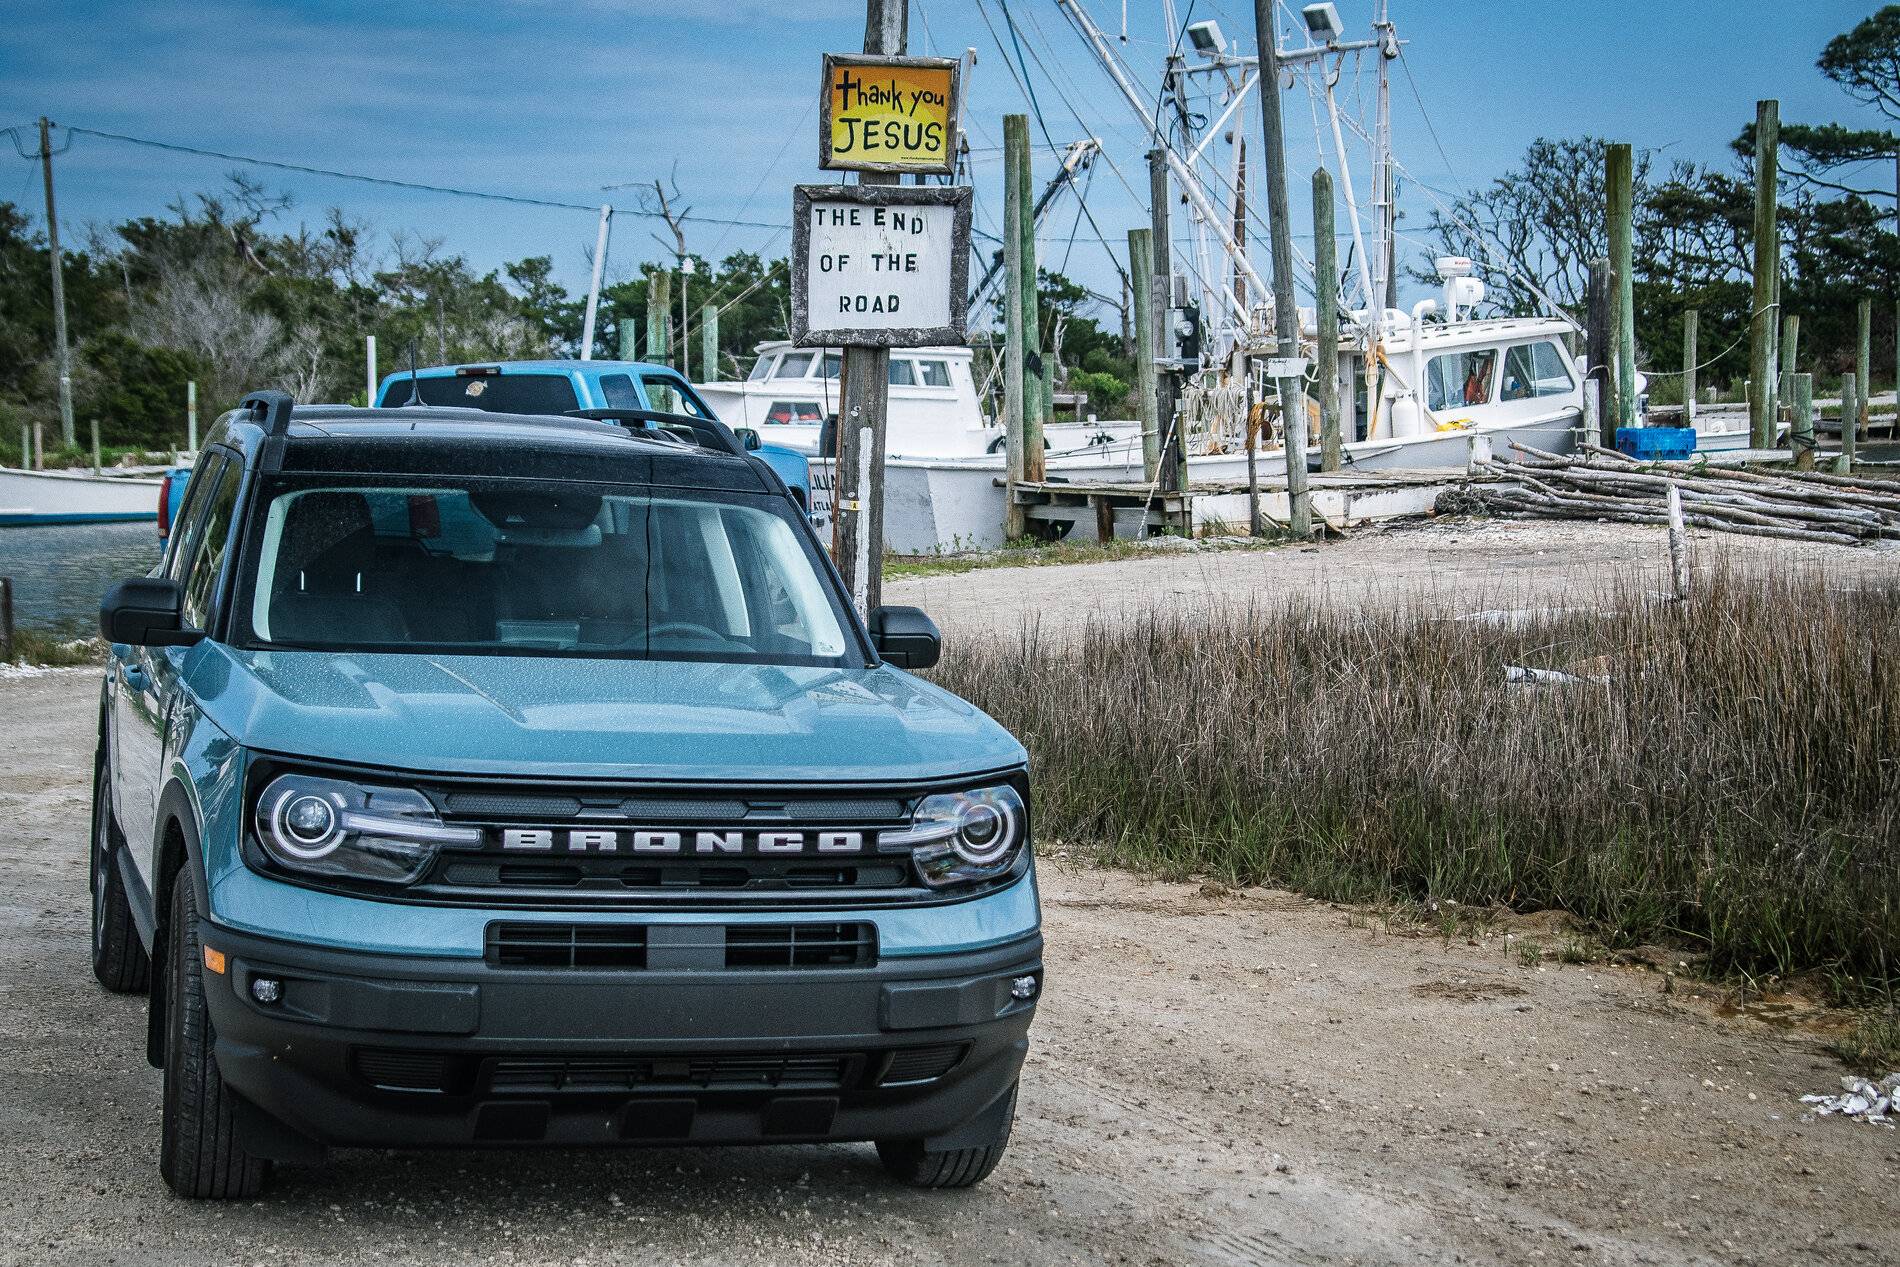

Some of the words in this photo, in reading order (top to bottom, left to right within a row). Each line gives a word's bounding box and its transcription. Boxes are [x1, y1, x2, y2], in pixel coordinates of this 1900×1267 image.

[909, 90, 945, 117] you
[834, 117, 943, 153] JESUS
[815, 208, 862, 226] THE
[873, 208, 924, 235] END
[820, 254, 850, 273] OF
[871, 253, 917, 273] THE
[839, 294, 900, 314] ROAD
[503, 829, 863, 853] BRONCO
